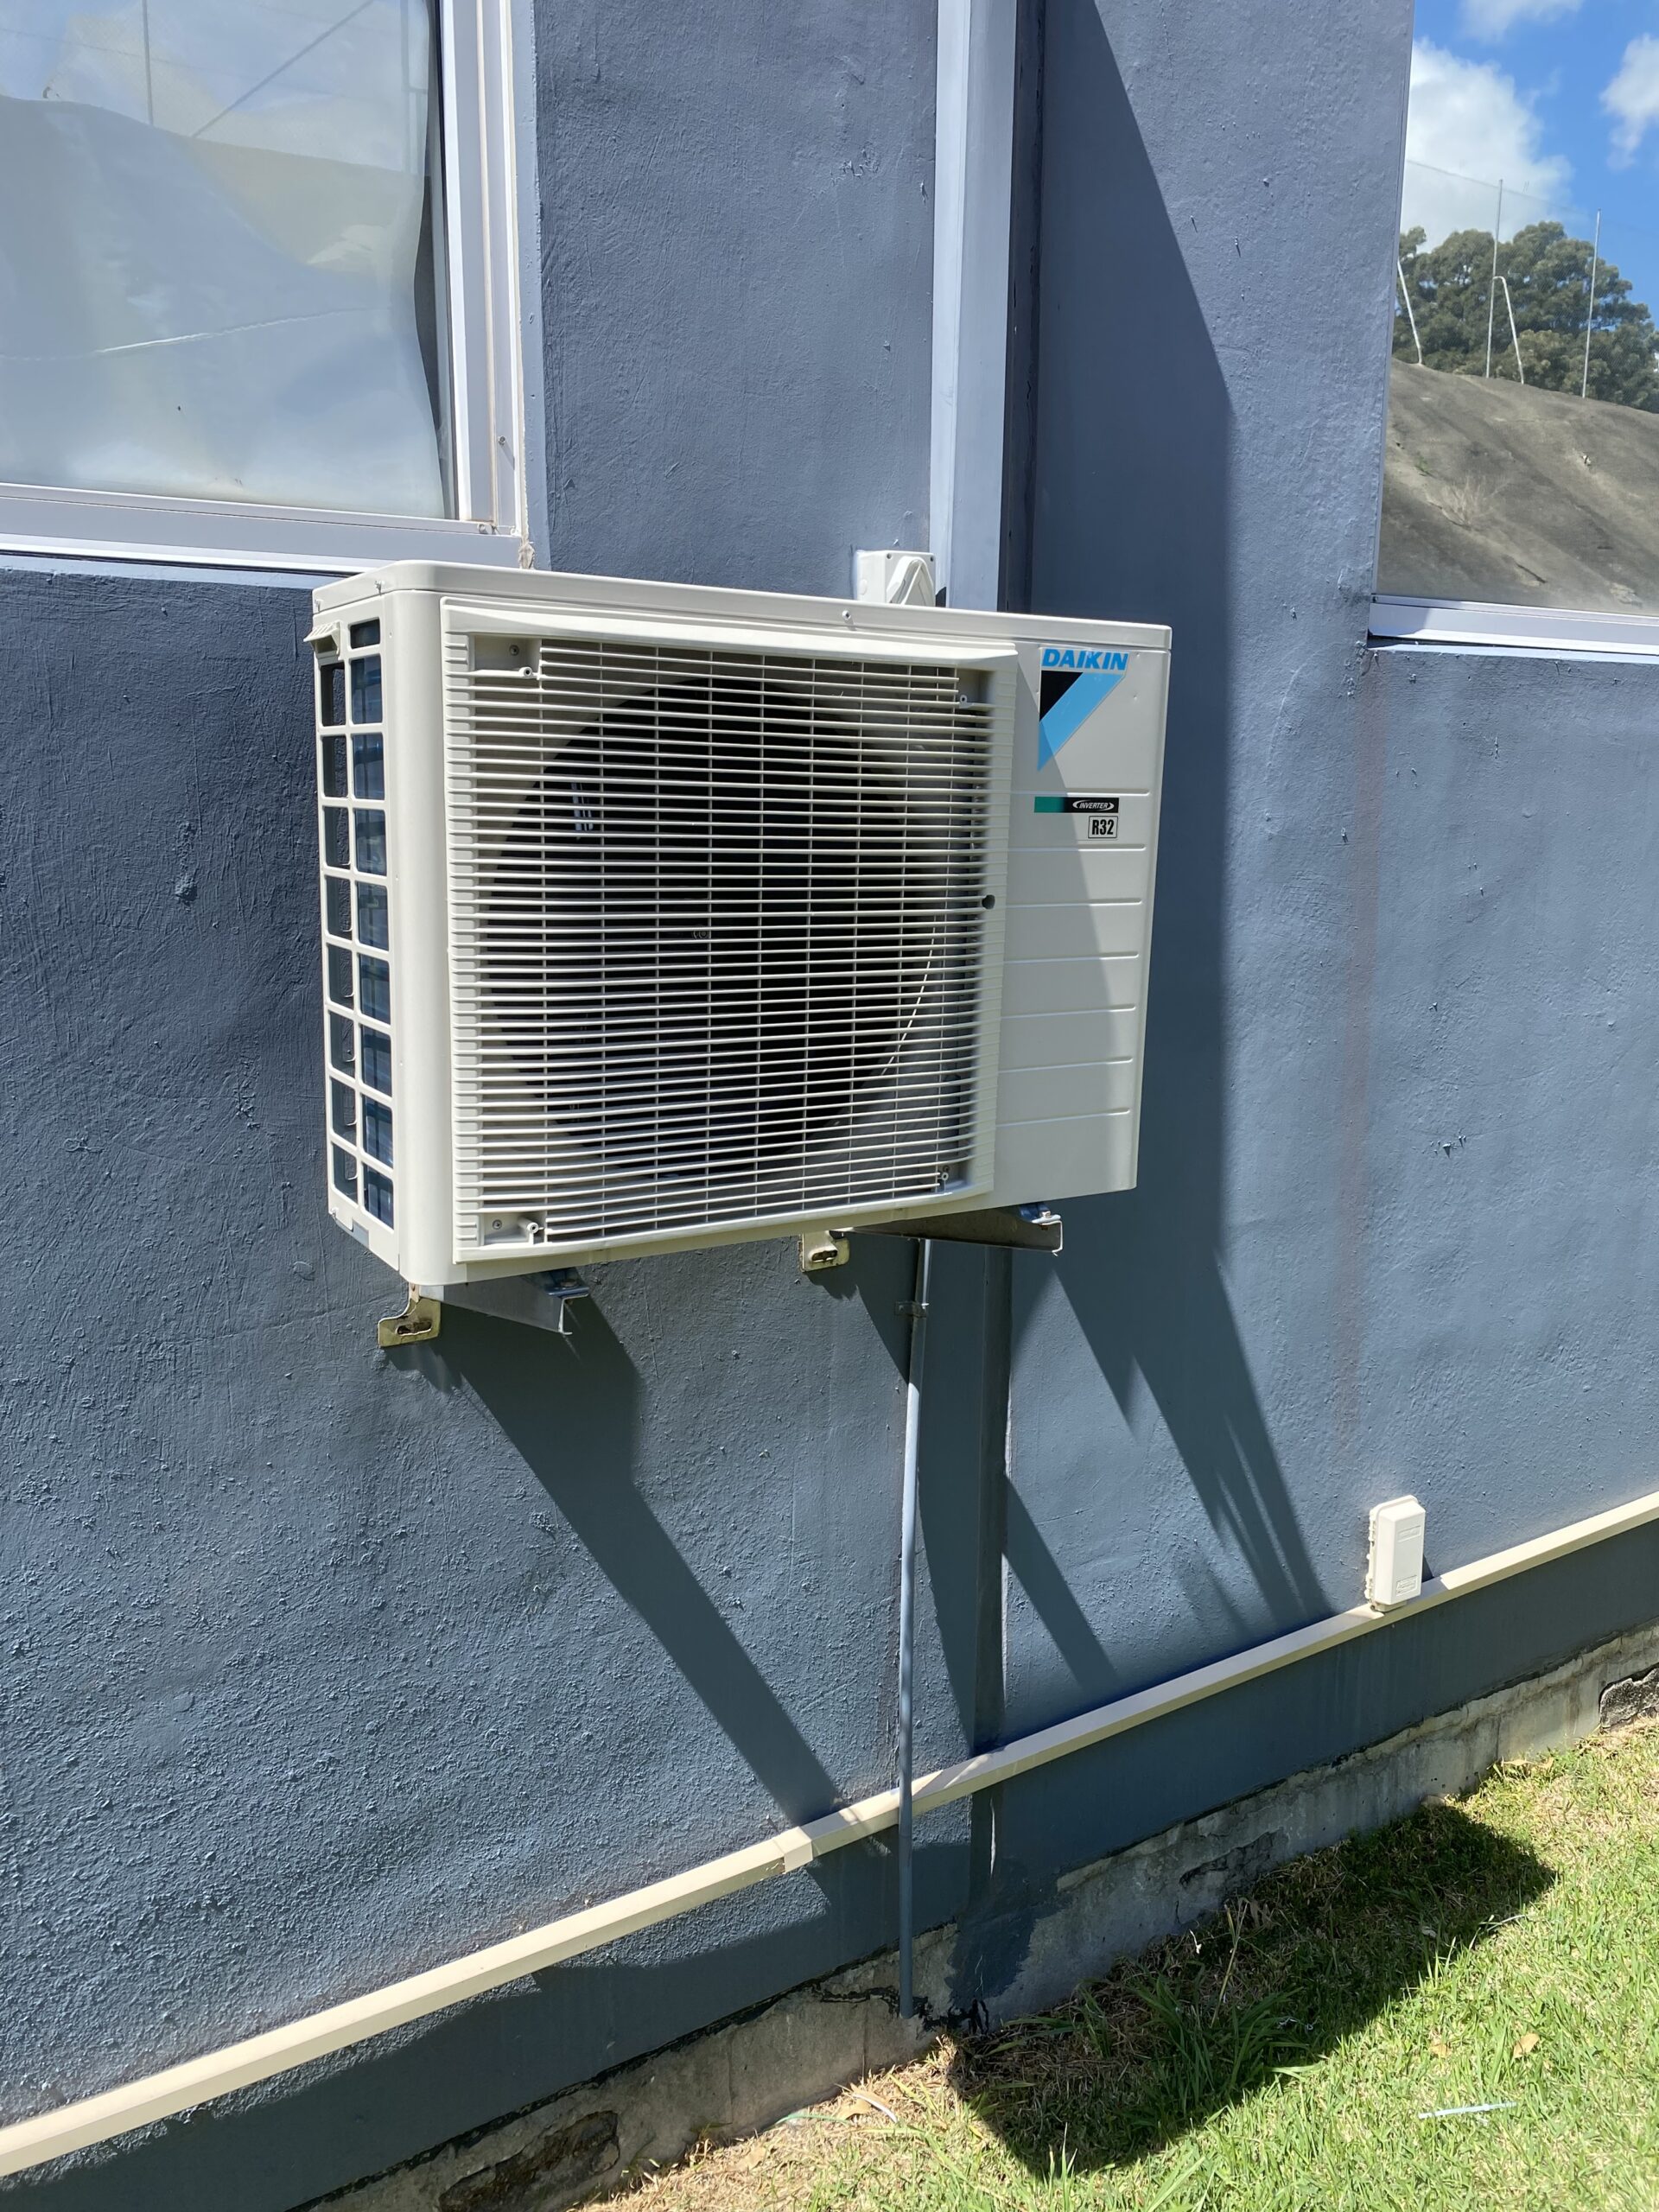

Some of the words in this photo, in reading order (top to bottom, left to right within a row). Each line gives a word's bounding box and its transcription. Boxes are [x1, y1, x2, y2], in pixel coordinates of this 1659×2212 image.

[1042, 649, 1128, 671] DAIKIN
[1078, 801, 1109, 810] INVERTER
[1091, 819, 1115, 836] R32
